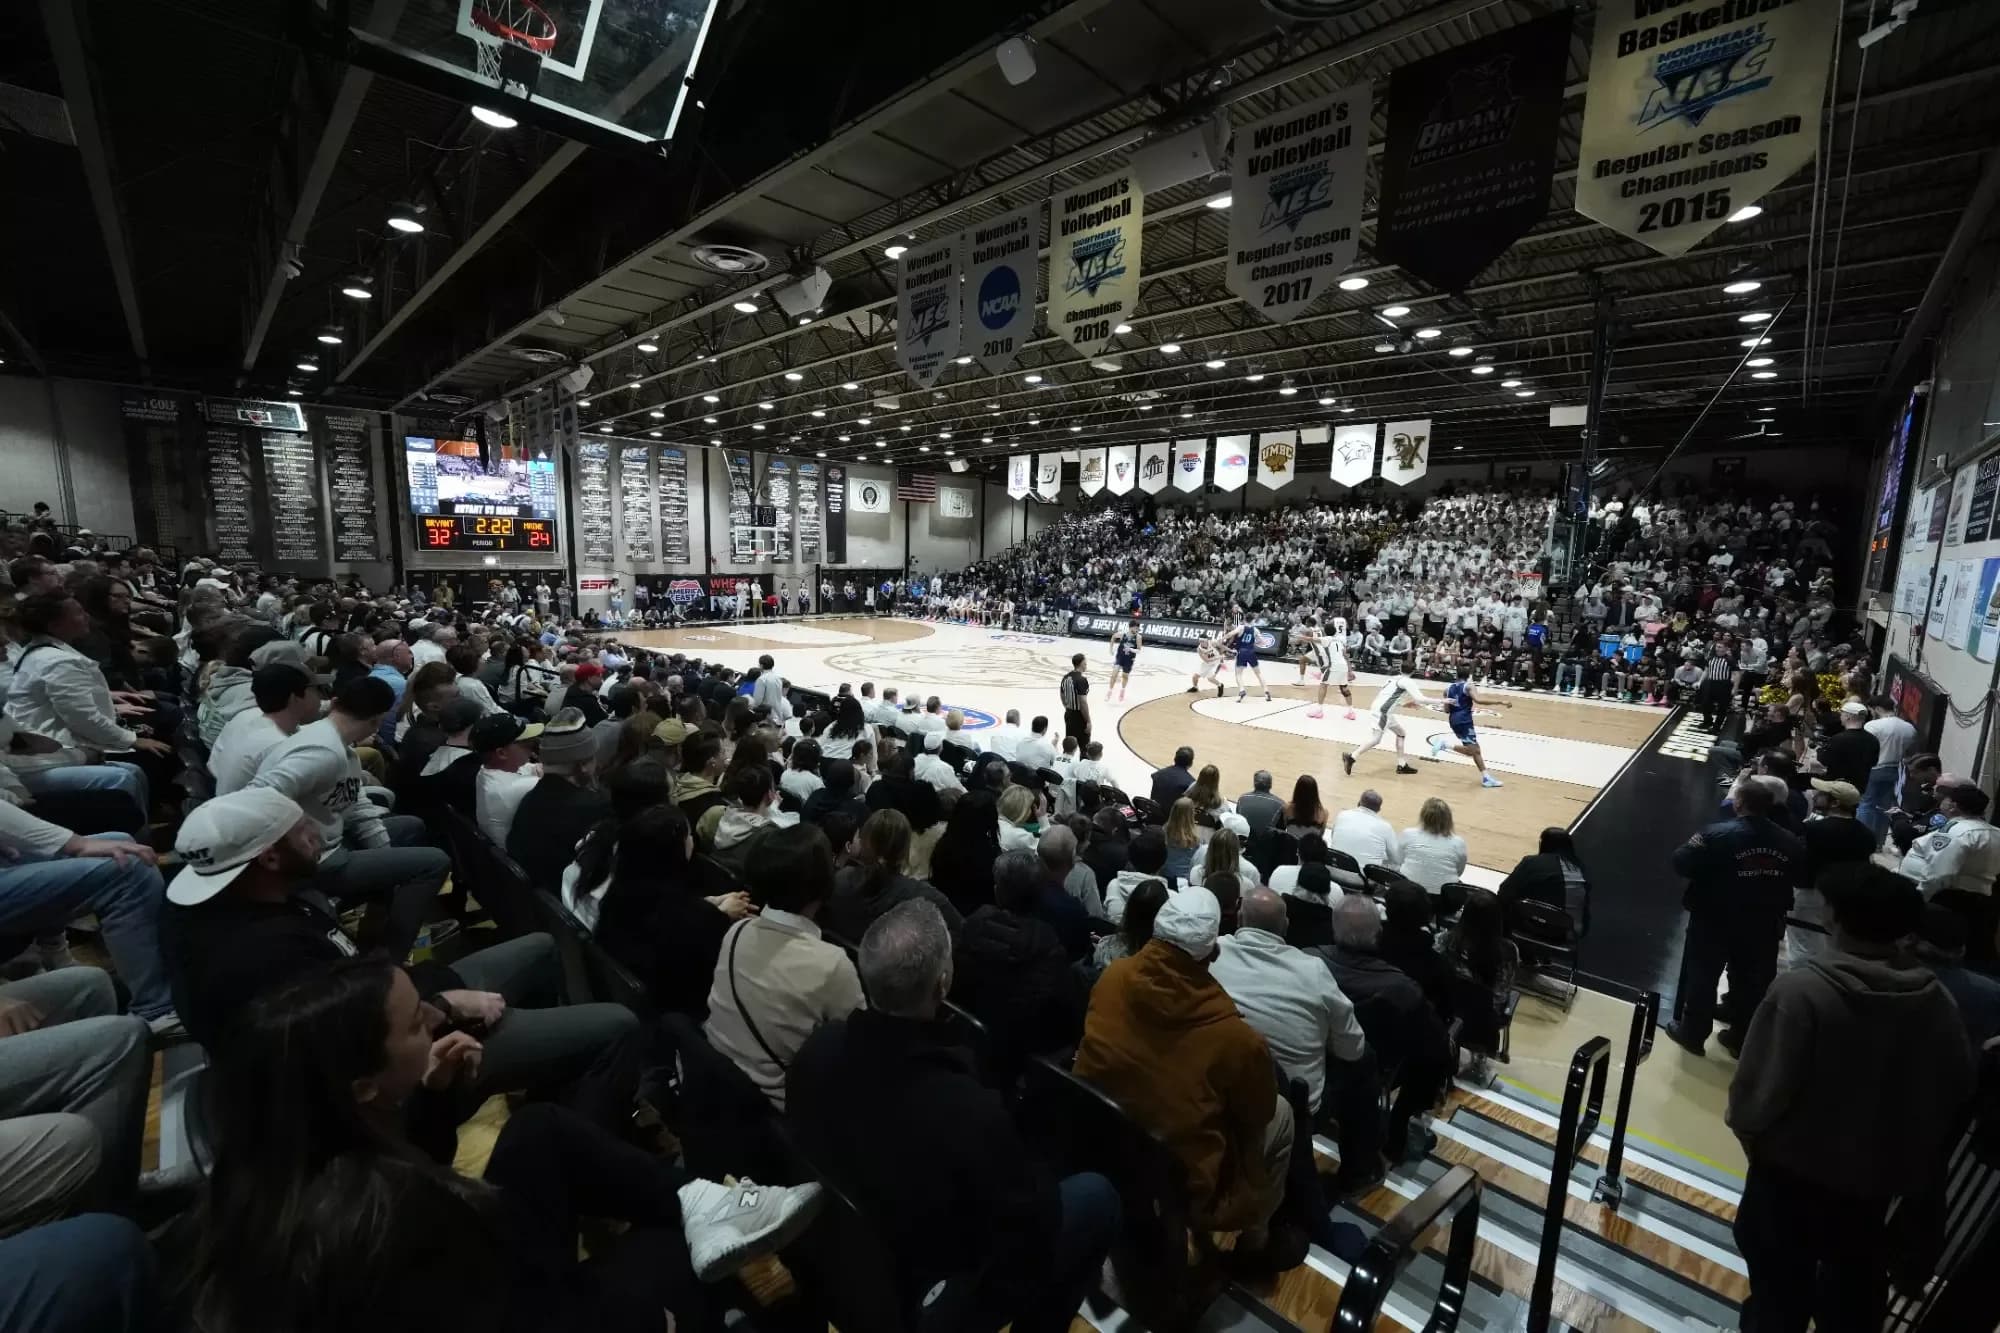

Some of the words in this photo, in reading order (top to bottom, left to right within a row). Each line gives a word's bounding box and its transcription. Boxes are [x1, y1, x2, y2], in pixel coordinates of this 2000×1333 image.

[1617, 0, 1796, 58] Basketba
[1658, 21, 1768, 62] NORTHEAST
[1638, 38, 1776, 125] NEC
[1254, 102, 1349, 149] Women's
[1248, 125, 1351, 177] Volleyball
[1594, 141, 1694, 178] Regular
[1697, 115, 1802, 155] Season
[1620, 151, 1768, 199] Champions
[1064, 177, 1130, 214] Women's
[1259, 171, 1336, 229] NEC
[1061, 197, 1131, 236] Volleyball
[1636, 187, 1731, 233] 2015
[975, 216, 1028, 245] Women's
[906, 247, 951, 272] Women's
[972, 233, 1030, 265] Volleyball
[1236, 241, 1292, 265] Regular
[1294, 227, 1351, 251] Season
[905, 263, 952, 290] Volleyball
[1065, 238, 1127, 292] NEC
[1251, 251, 1334, 281] Champions
[982, 292, 1021, 318] NCAA
[1263, 277, 1313, 307] 2017
[1065, 301, 1123, 323] Champions
[1073, 320, 1110, 343] 2018
[1261, 443, 1294, 461] UMBC
[426, 519, 455, 528] BRYANT
[428, 528, 450, 545] 32
[476, 518, 512, 534] 2:22
[523, 522, 544, 531] MAINE
[472, 539, 494, 547] PERIOD
[499, 538, 505, 549] 1
[530, 531, 550, 546] 24
[668, 588, 703, 596] AMERICA
[1091, 618, 1117, 632] JERSEY
[1145, 623, 1181, 638] AMERICA
[1242, 633, 1252, 643] 10
[1338, 625, 1343, 634] 5
[1335, 642, 1339, 652] 1
